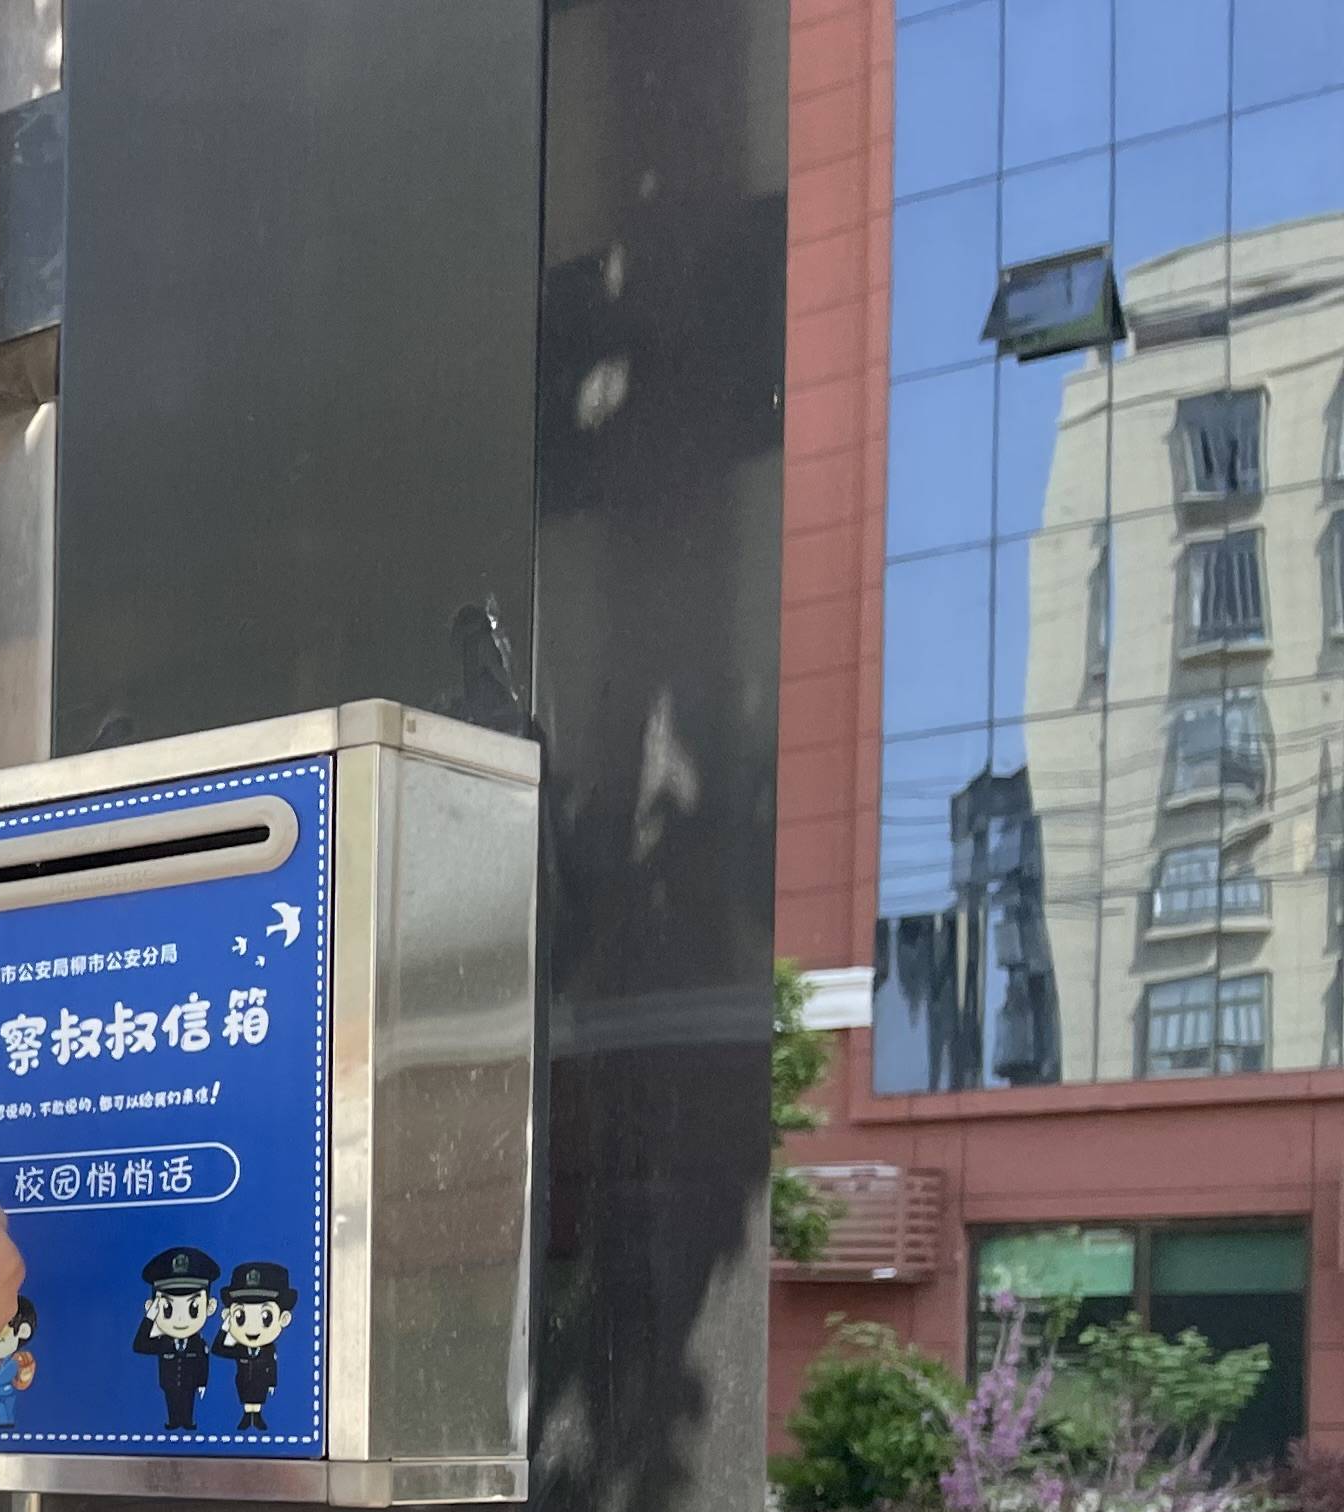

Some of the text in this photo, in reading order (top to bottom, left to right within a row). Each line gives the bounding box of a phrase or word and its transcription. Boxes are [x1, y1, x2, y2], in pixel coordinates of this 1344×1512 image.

[14, 1155, 193, 1202] 校园悄悄话
